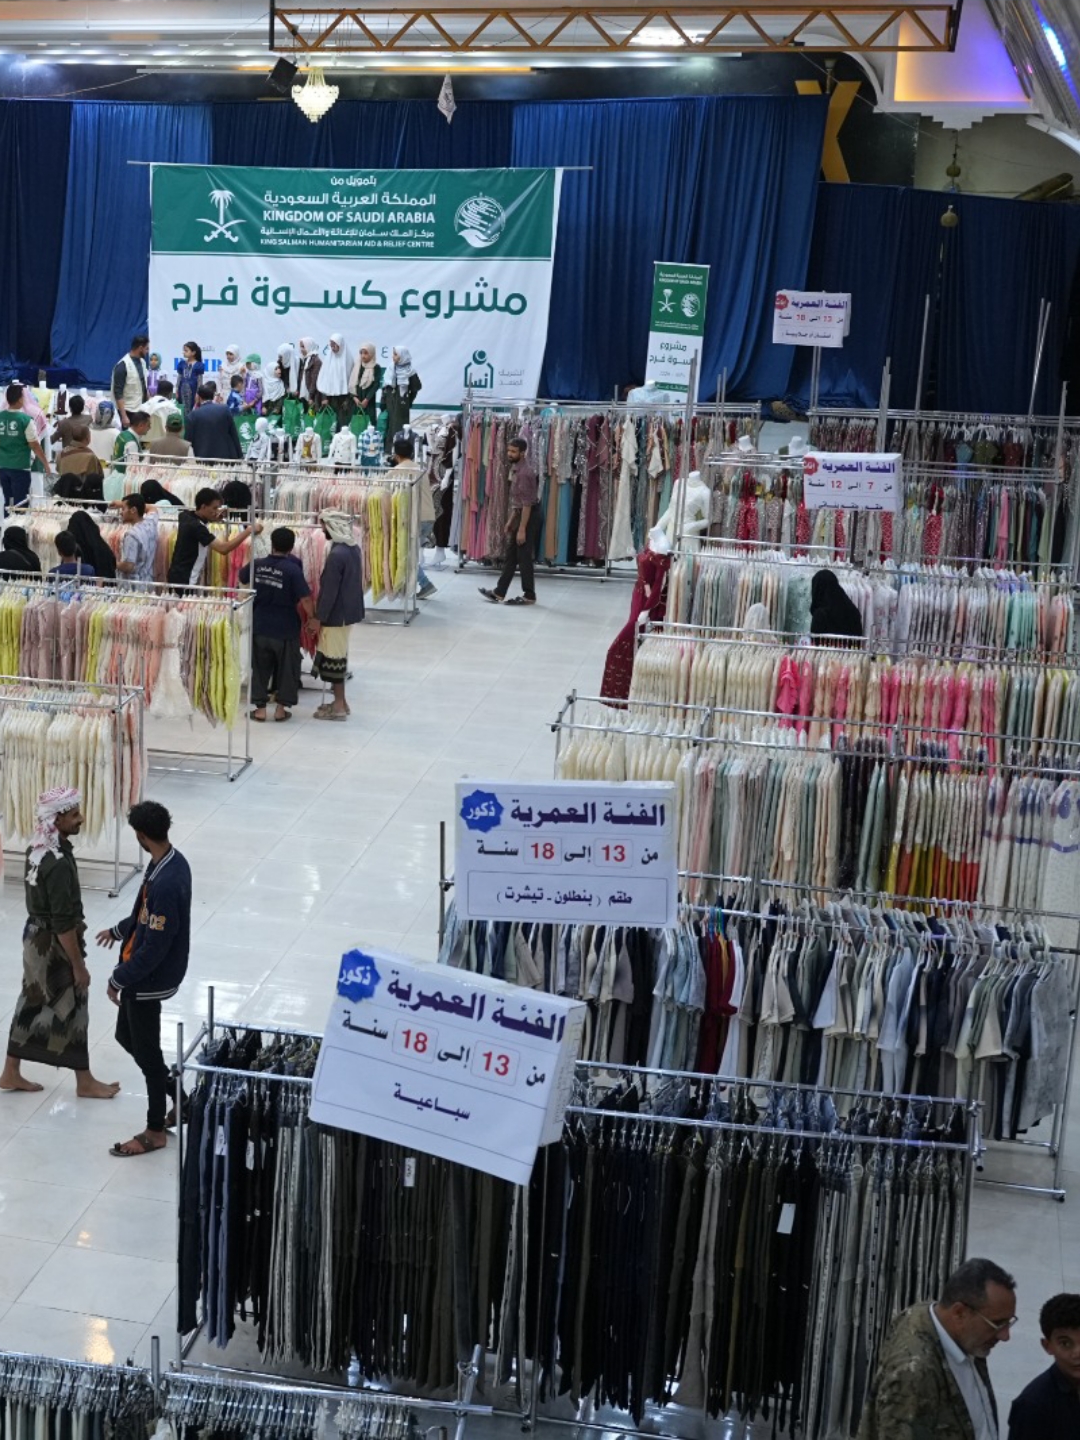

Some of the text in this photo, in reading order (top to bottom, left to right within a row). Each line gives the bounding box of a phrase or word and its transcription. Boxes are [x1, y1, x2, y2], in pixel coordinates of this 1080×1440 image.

[330, 175, 377, 187] بتمويل من
[264, 190, 436, 208] المملكة العربية السعودية
[263, 210, 436, 224] KINGDOM OF SAUDI ARABIA
[171, 276, 528, 319] مشروع كسوة فرح
[822, 459, 863, 474] العمرية
[865, 461, 895, 474] الفئة
[831, 480, 843, 489] 12
[867, 481, 874, 490] 7
[466, 799, 665, 828] ذكور الفئة العمرية
[476, 839, 659, 864] من 13 إلى 18 سنة
[554, 890, 593, 907] بنطلون
[608, 891, 633, 906] طقم
[338, 964, 567, 1043] ذكور الفئة العمرية
[341, 1009, 546, 1087] من 13 إلى 18 سنة
[393, 1082, 471, 1122] سباعية
